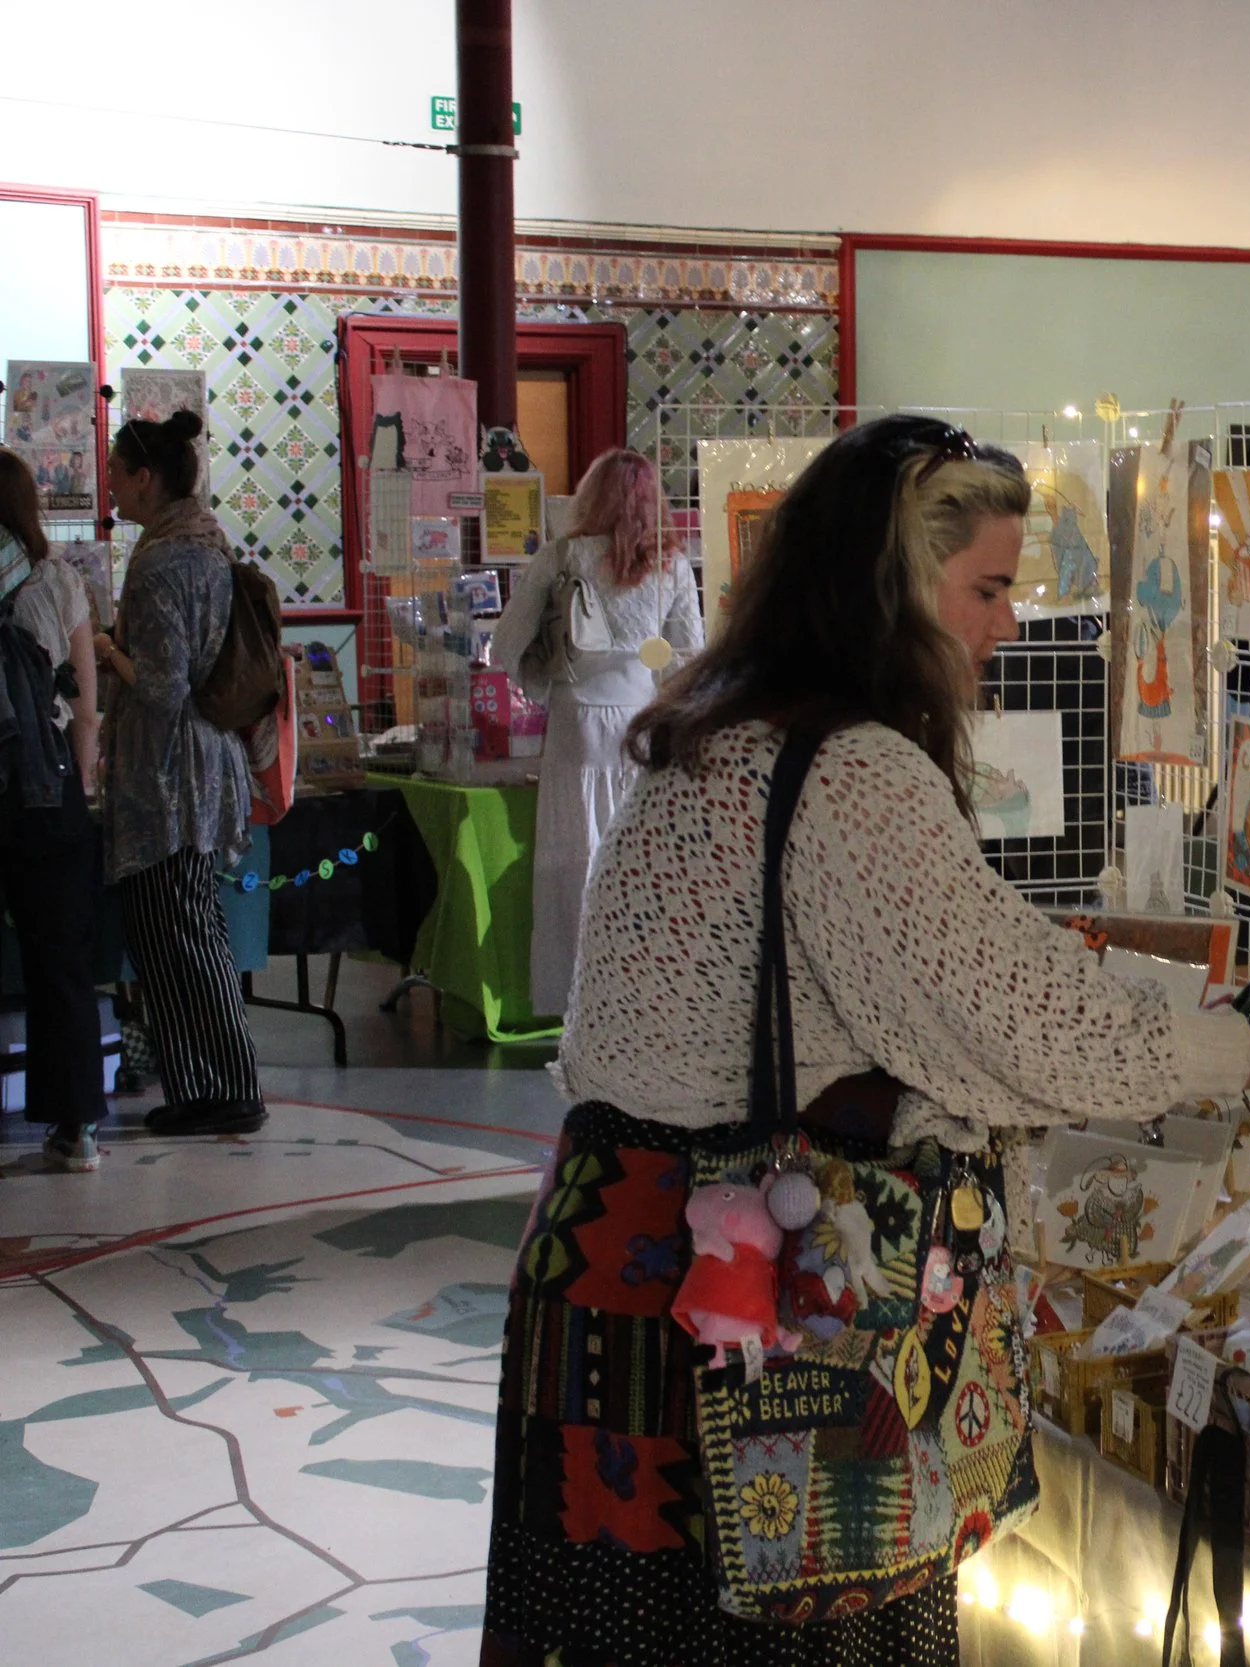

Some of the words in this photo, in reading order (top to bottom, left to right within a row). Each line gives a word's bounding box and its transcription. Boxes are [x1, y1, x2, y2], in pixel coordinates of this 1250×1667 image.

[435, 99, 457, 113] FIR
[435, 115, 457, 128] EX
[934, 1297, 970, 1384] LOVE
[760, 1369, 831, 1395] BEAVER
[759, 1393, 843, 1421] BELIEVER
[1176, 1379, 1203, 1424] £22
